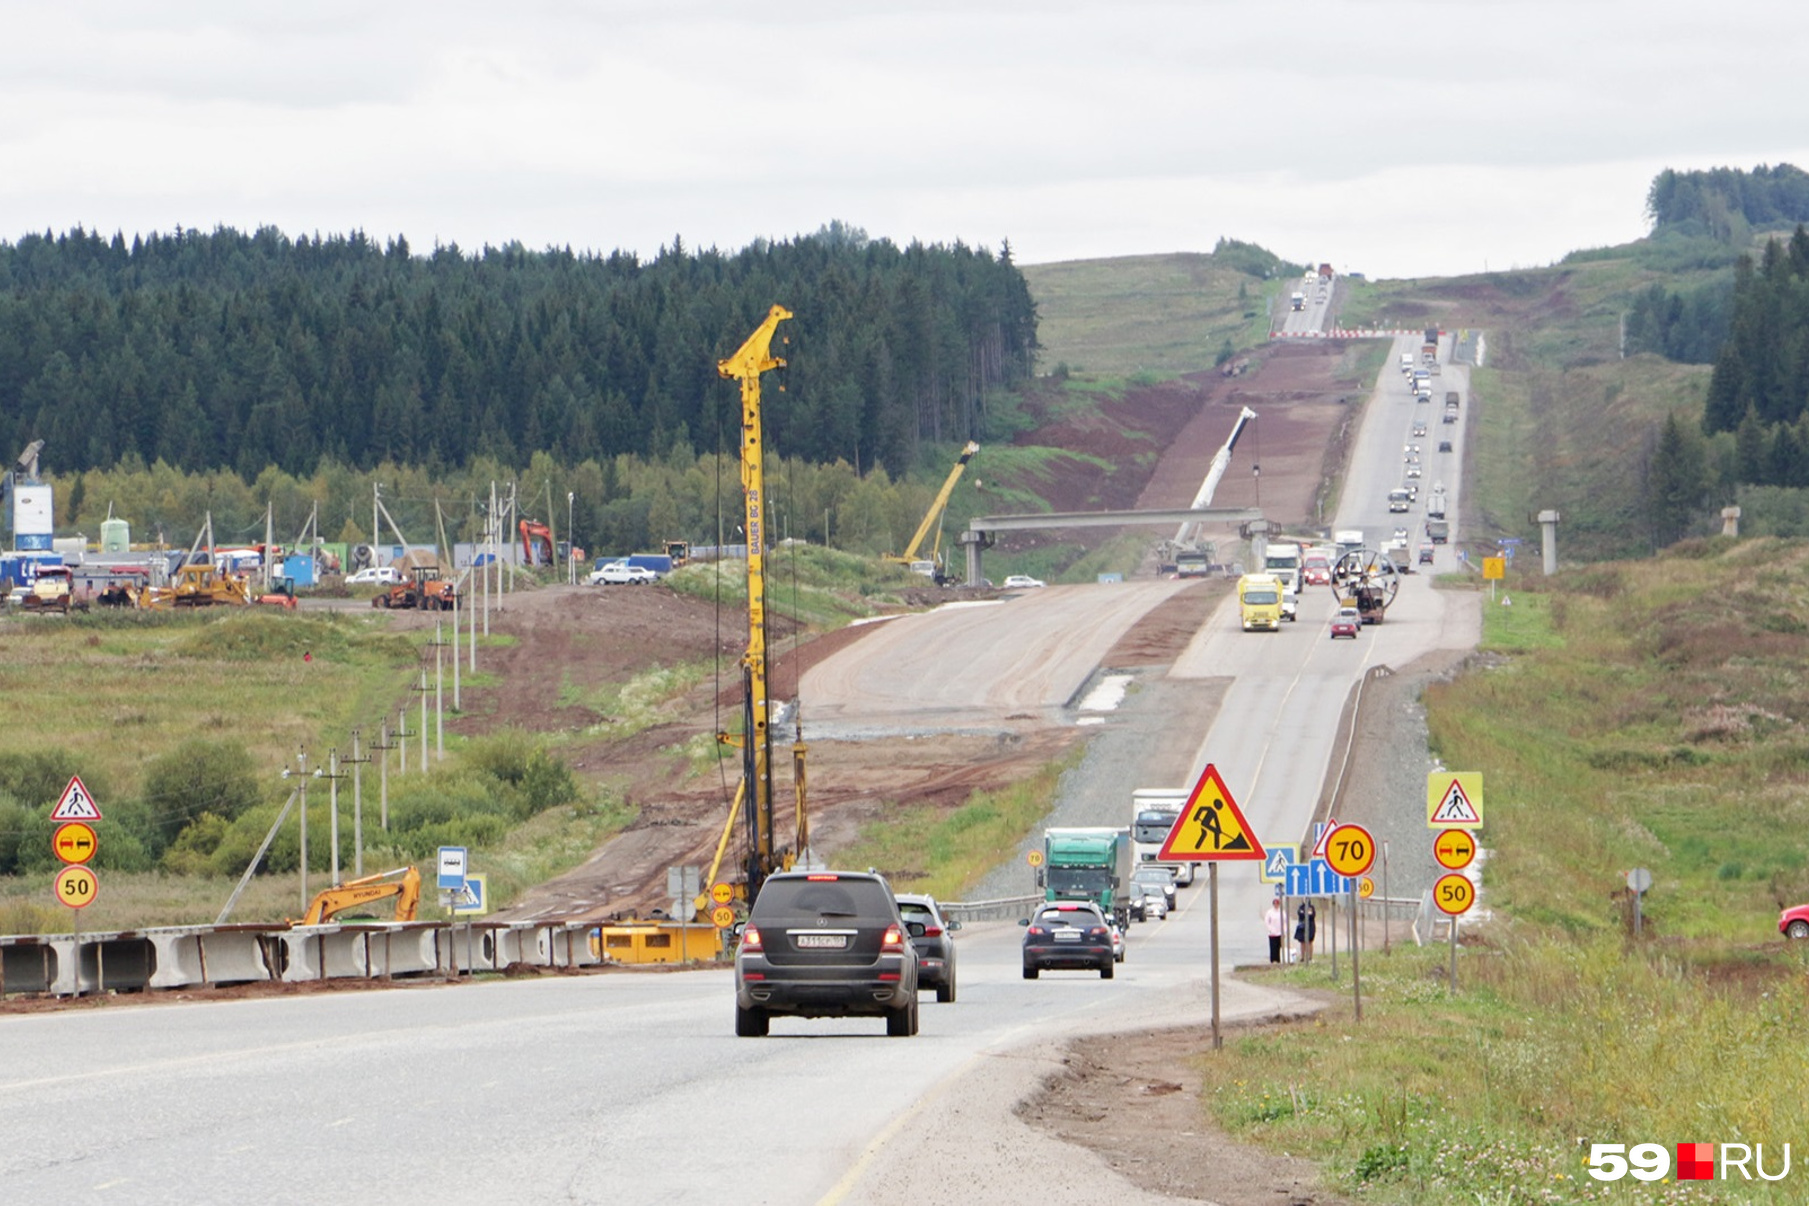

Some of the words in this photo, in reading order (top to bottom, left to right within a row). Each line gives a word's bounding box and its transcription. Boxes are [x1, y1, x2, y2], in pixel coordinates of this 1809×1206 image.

[749, 490, 758, 501] 28
[750, 505, 759, 518] BG
[750, 521, 760, 554] BAUER
[1336, 840, 1364, 861] 70
[65, 879, 89, 896] 50
[1442, 885, 1466, 902] 50
[716, 911, 730, 921] 50
